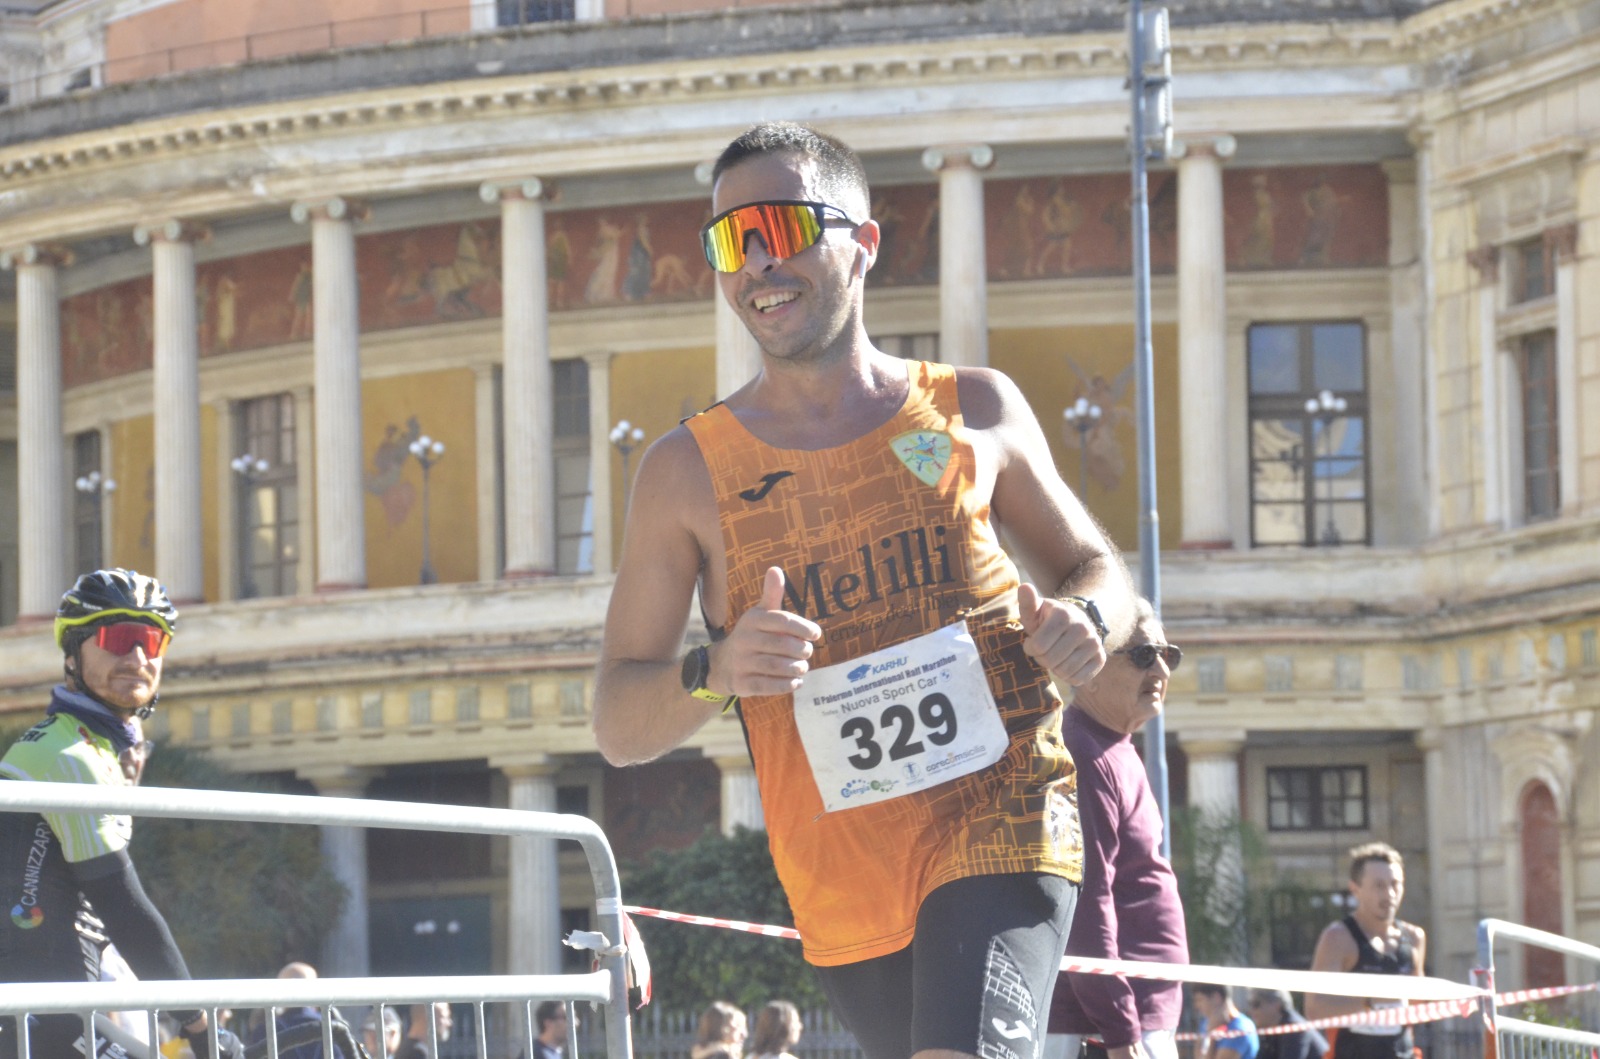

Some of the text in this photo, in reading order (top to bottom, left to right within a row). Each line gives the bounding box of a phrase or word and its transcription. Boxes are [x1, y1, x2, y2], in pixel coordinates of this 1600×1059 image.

[782, 525, 957, 623] Melilli
[821, 689, 853, 704] Palermo
[854, 673, 904, 694] International
[906, 666, 921, 678] Half
[922, 654, 957, 673] Marathon
[871, 656, 908, 675] KARHU
[840, 693, 881, 714] Nuova
[882, 682, 916, 701] Sport
[917, 676, 938, 690] Car
[840, 692, 958, 770] 329
